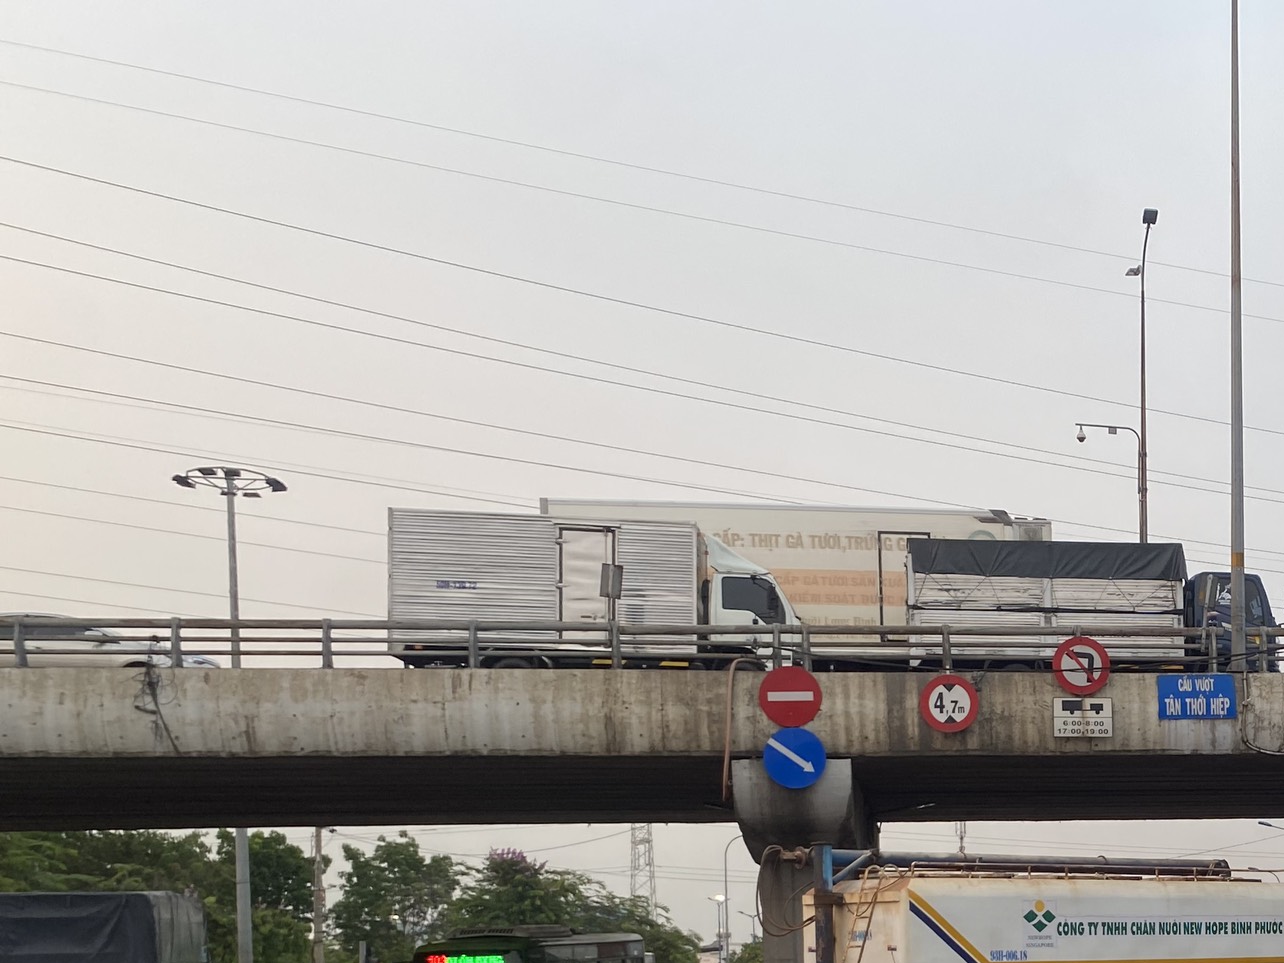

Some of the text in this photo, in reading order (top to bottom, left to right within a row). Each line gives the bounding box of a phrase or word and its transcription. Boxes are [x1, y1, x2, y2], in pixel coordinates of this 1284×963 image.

[748, 533, 780, 551] THỊT
[785, 531, 804, 549] GÀ
[1178, 678, 1215, 695] CẦU VƯỢT
[1165, 693, 1230, 718] TÂN THỚI HIỆP
[1056, 919, 1085, 936] CÔNG
[1087, 921, 1099, 936] TY
[1101, 921, 1128, 936] TNHH
[1158, 919, 1181, 935] NUÔI
[1183, 921, 1202, 935] NEW
[1205, 920, 1229, 935] HOPE
[1231, 918, 1252, 935] BÌNH
[1254, 918, 1283, 935] PHƯỚC
